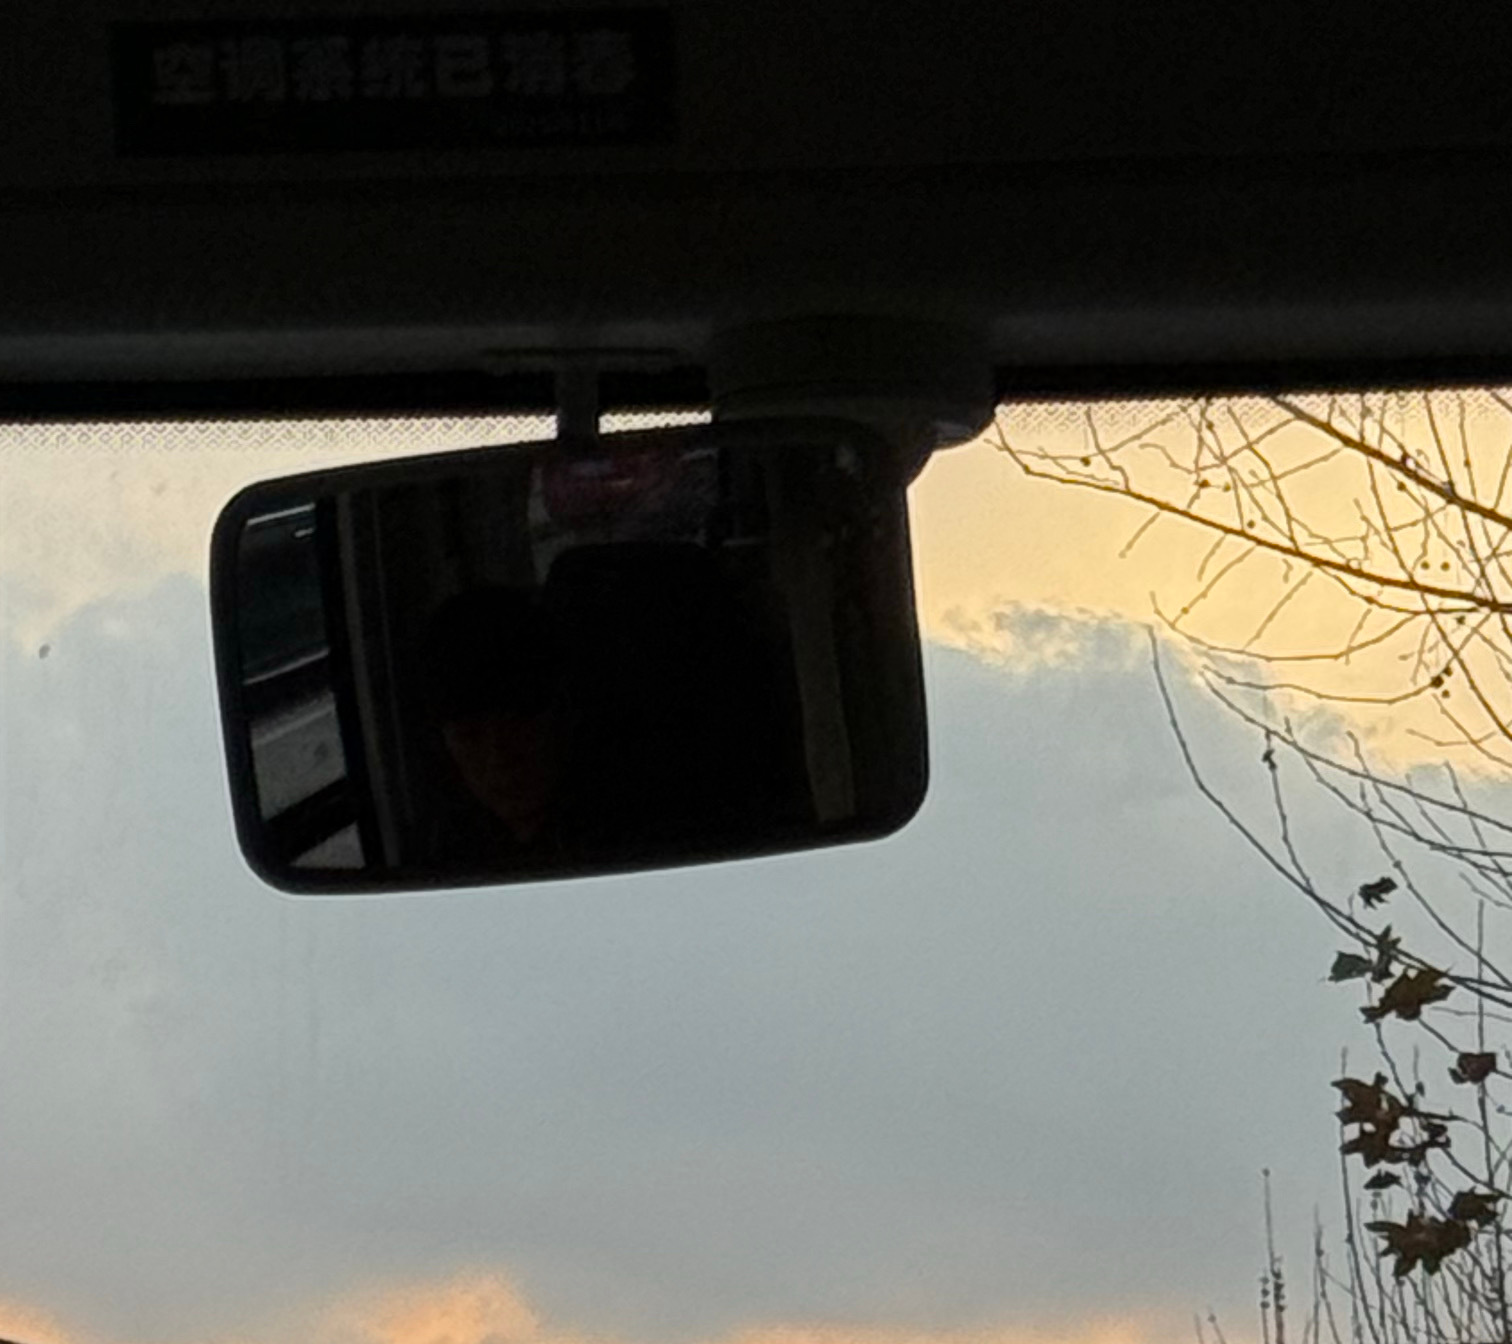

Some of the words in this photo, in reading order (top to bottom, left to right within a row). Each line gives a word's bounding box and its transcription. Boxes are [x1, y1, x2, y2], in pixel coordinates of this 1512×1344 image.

[151, 28, 636, 104] 空调系统已消毒
